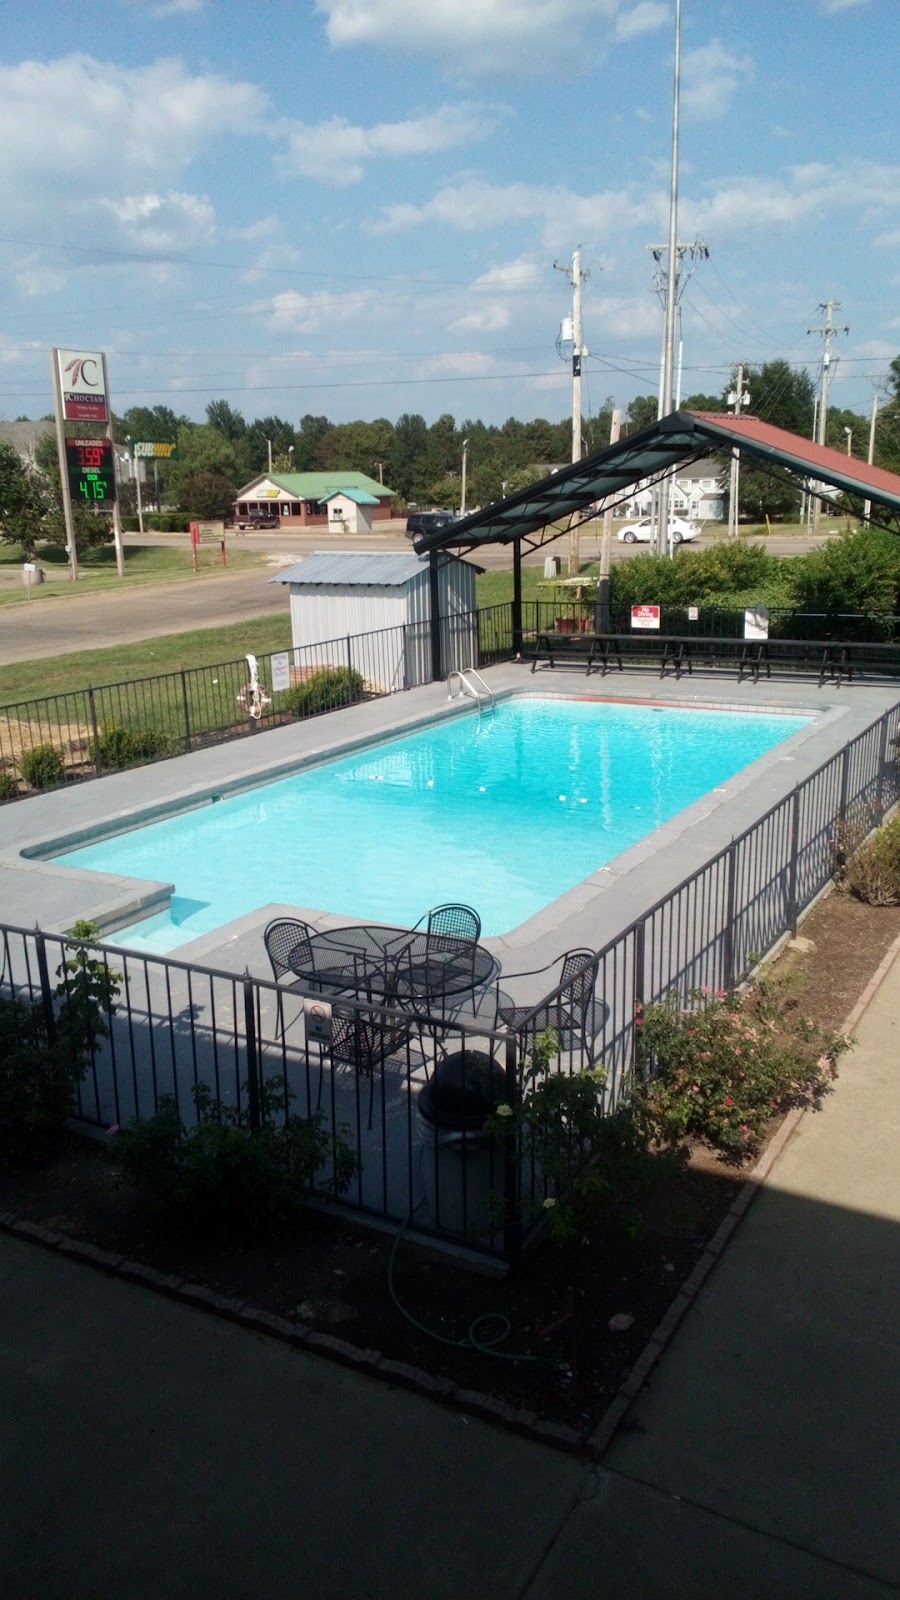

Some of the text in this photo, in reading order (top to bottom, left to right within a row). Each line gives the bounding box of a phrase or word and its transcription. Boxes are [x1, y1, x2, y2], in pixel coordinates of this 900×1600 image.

[68, 393, 104, 403] CHOCTAW
[134, 442, 176, 458] SUBWAY
[82, 466, 101, 474] DIESEL
[256, 489, 280, 498] SUBWAY
